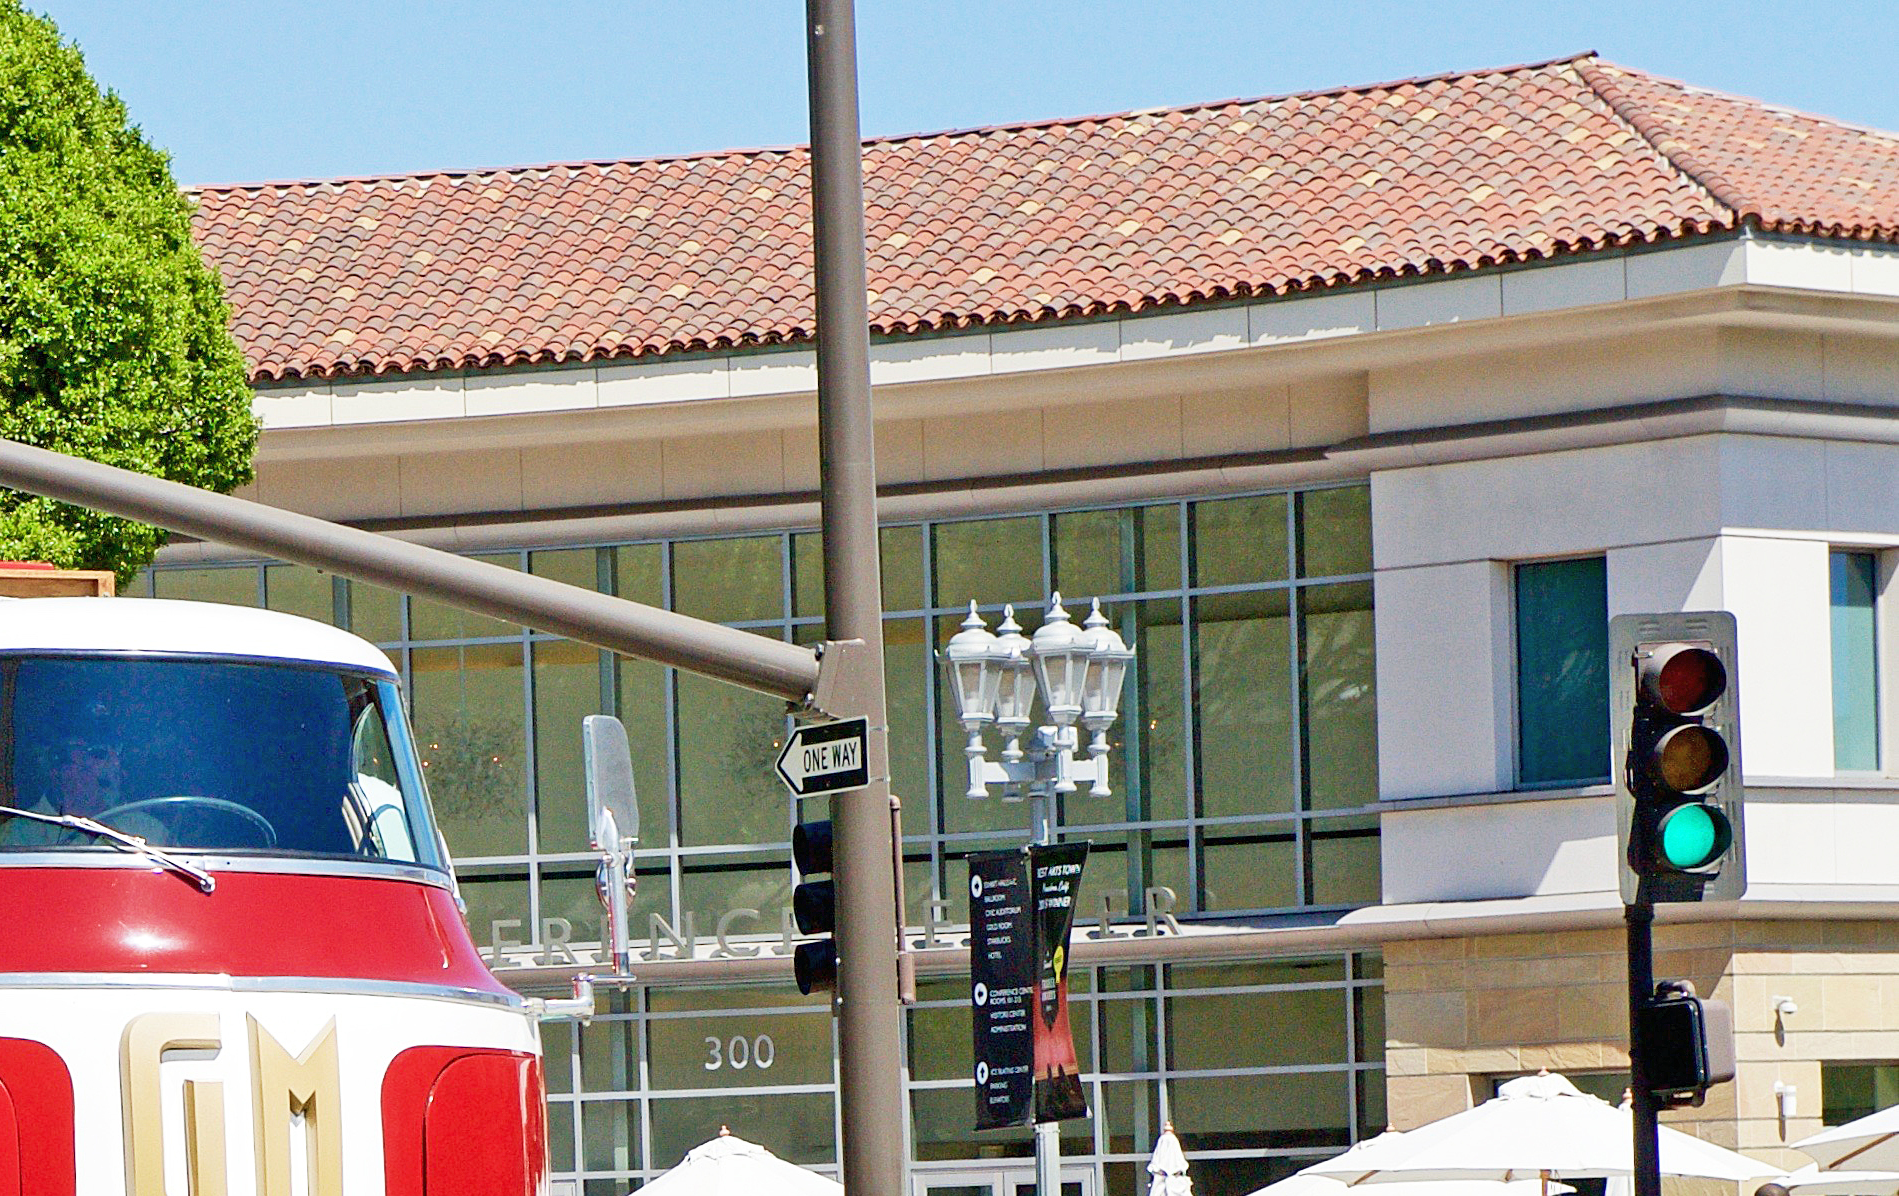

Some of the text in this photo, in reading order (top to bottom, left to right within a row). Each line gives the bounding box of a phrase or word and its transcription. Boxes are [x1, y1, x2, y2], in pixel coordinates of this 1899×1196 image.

[803, 742, 857, 773] ONE WAY
[704, 1034, 775, 1070] 300
